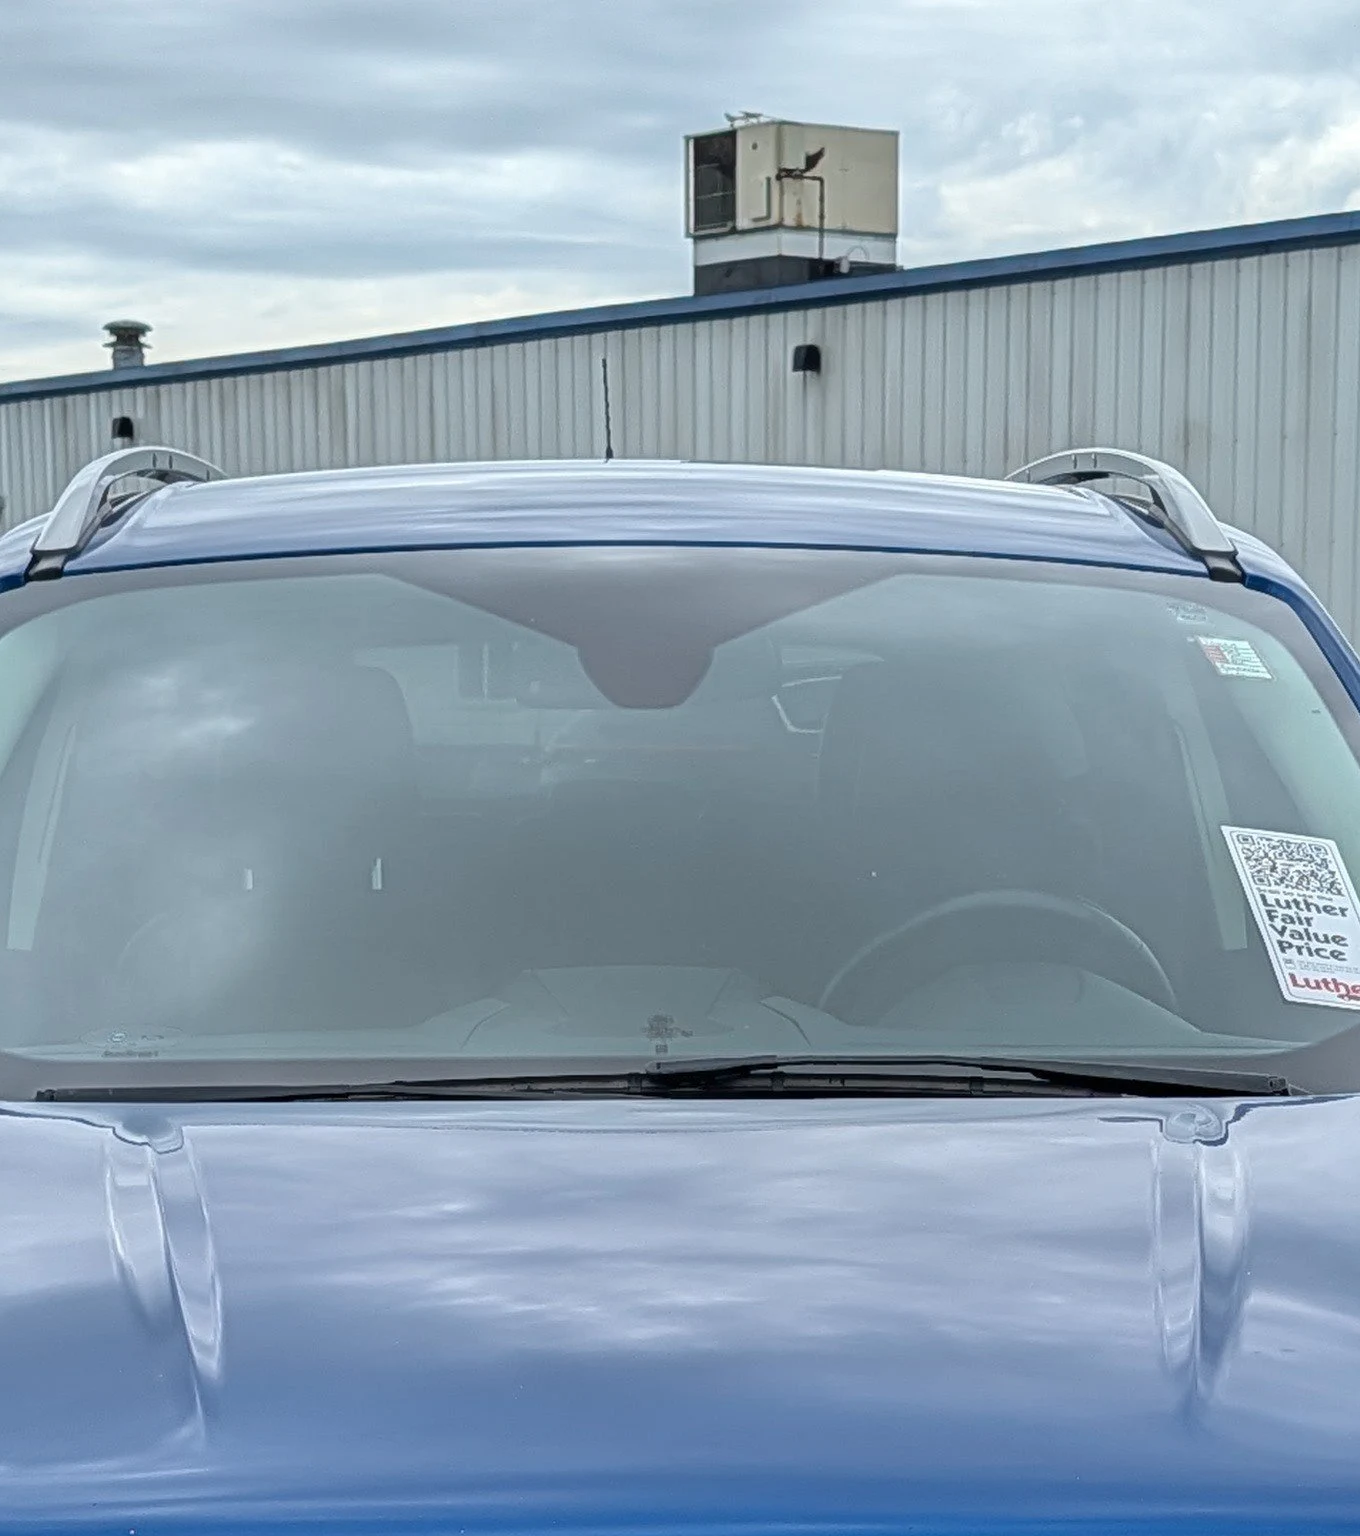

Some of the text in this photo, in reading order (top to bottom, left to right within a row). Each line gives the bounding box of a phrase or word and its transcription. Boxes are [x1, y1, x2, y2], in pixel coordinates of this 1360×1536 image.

[1260, 893, 1349, 917] Luther
[1265, 909, 1314, 927] Fair
[1269, 923, 1349, 947] Value
[1276, 940, 1348, 961] Price
